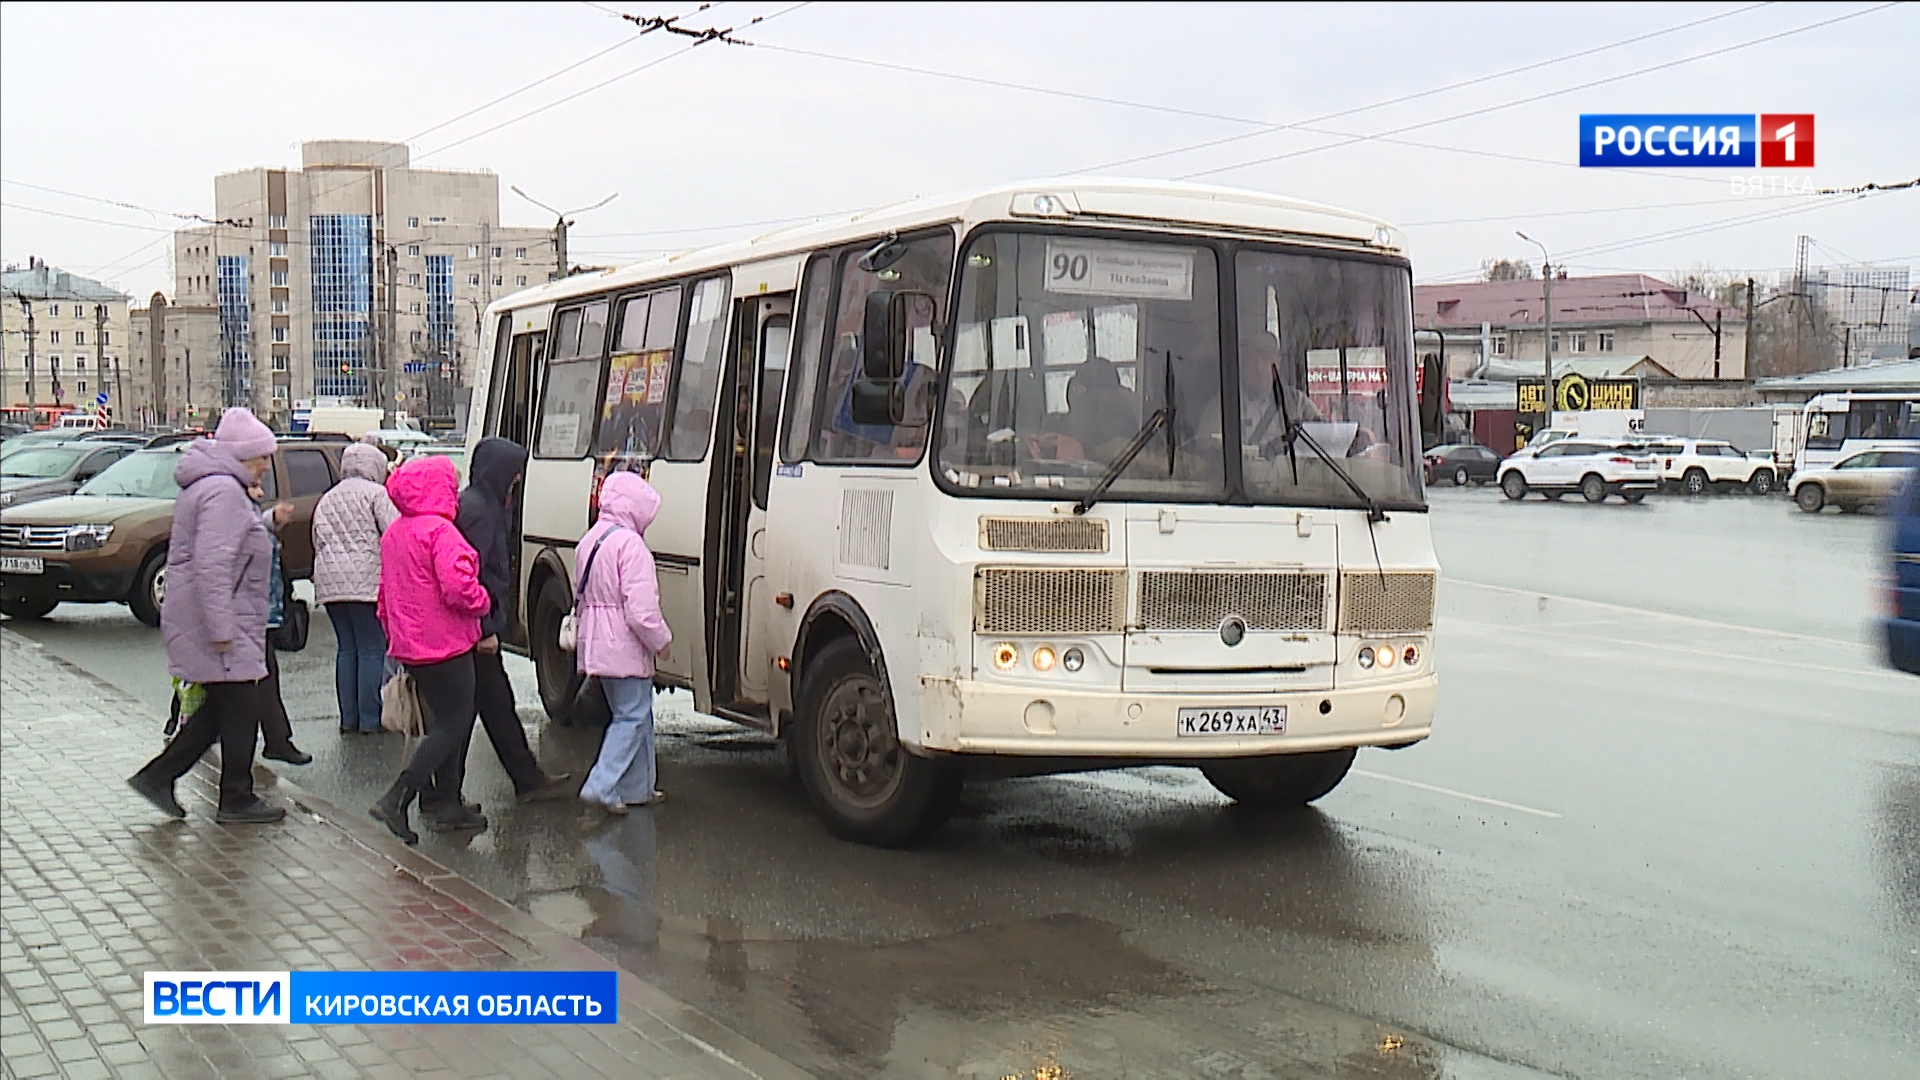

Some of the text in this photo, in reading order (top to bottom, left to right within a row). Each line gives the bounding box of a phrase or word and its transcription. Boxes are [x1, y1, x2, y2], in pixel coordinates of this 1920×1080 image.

[1052, 252, 1089, 282] 90
[1590, 384, 1633, 400] ШИНО
[1185, 708, 1280, 732] К269ХА 43
